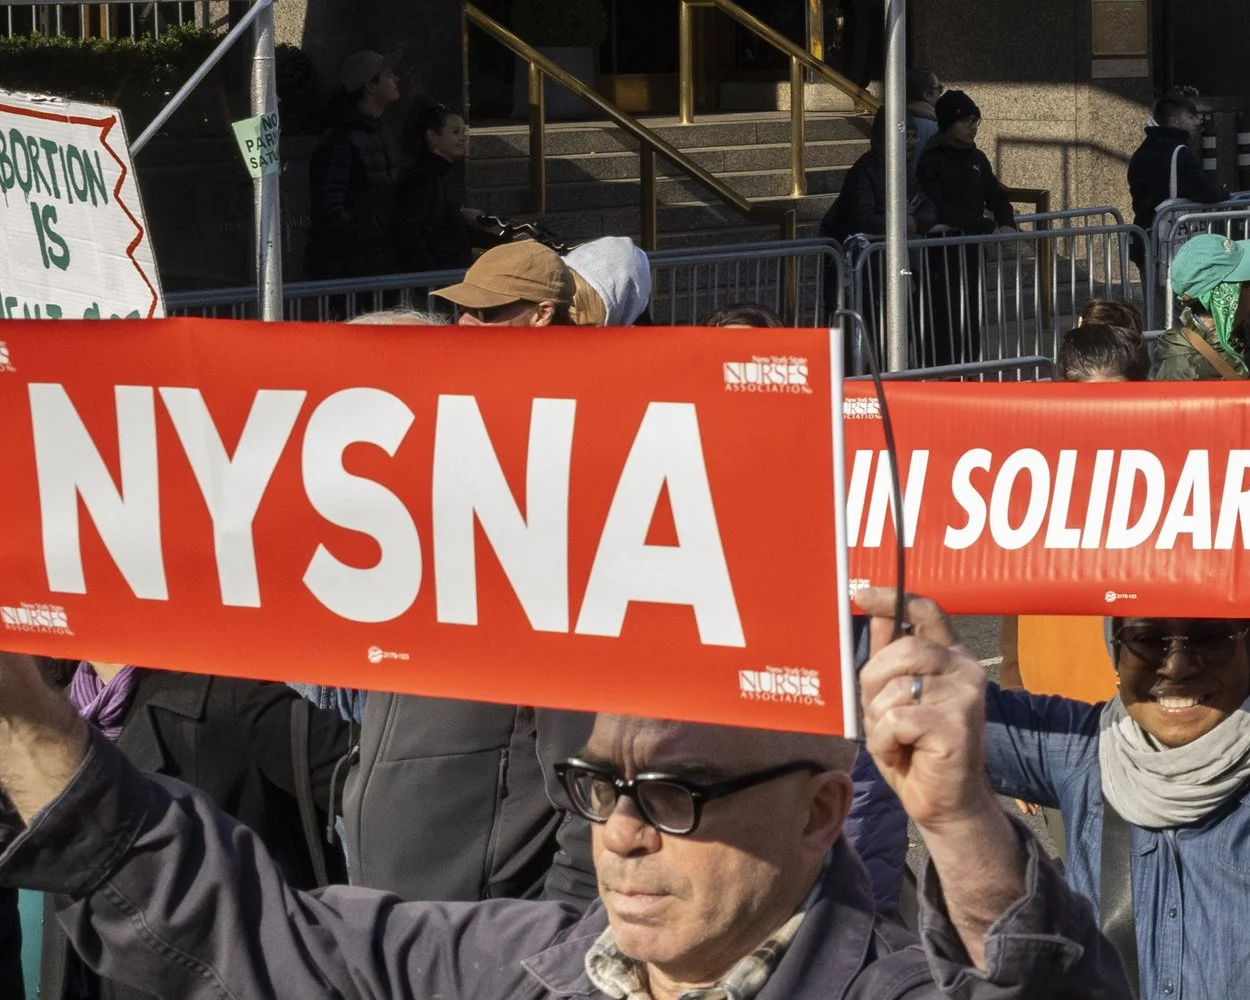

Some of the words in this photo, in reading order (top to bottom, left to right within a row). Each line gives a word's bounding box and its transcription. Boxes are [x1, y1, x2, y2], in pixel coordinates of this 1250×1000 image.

[261, 112, 277, 131] NO
[0, 127, 109, 208] BORTION
[30, 201, 71, 271] IS
[723, 362, 809, 385] NURSES
[724, 383, 813, 394] ASSOCIATION
[846, 449, 929, 548] IN
[27, 382, 747, 648] NYSNA
[0, 606, 68, 628] NURSES
[738, 669, 820, 697] NURSES
[740, 690, 826, 707] ASSOCIATION
